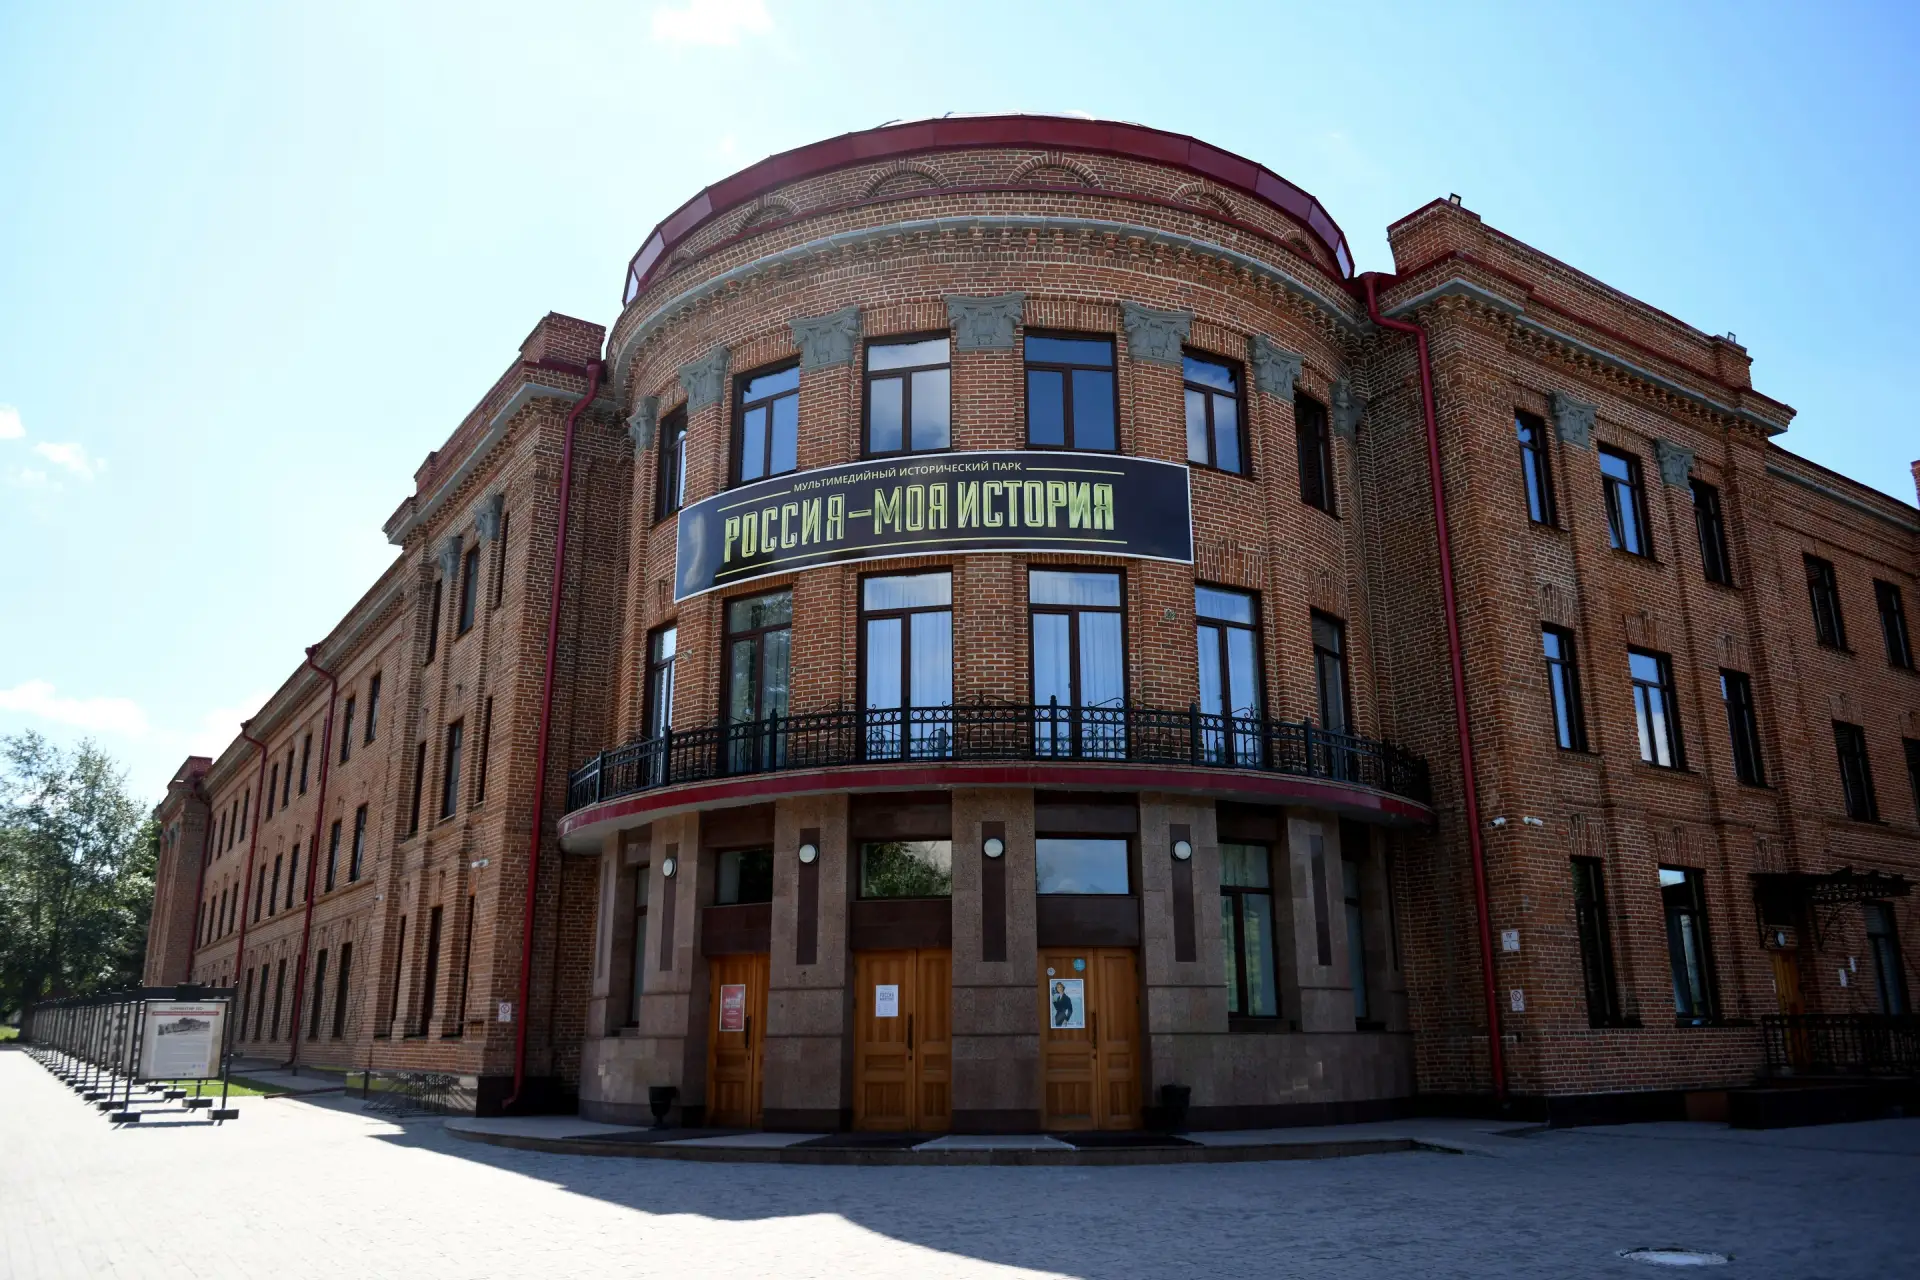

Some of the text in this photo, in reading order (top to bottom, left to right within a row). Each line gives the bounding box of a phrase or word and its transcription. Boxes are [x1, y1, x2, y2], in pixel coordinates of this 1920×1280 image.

[793, 460, 1022, 492] МУЛЬТИМЕДИЙНЫЙ ИСТОРИЧЕСКИЙ ПАРК
[957, 480, 1115, 531] ИСТОРИЯ
